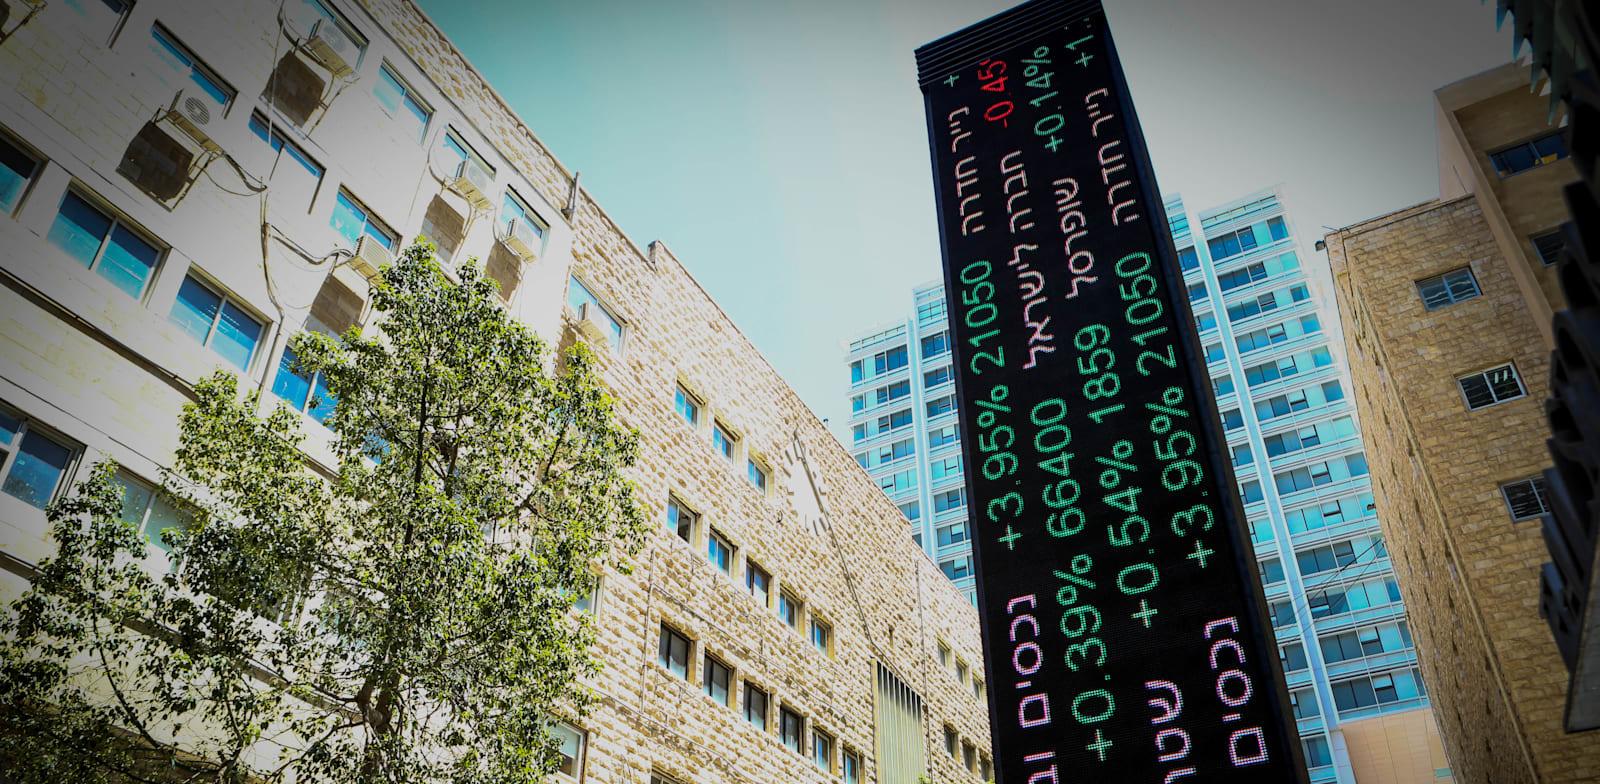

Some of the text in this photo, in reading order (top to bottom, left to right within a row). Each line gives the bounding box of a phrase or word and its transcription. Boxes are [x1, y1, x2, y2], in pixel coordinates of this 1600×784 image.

[948, 106, 972, 153] נייר
[1021, 45, 1065, 152] +0.14%
[1085, 87, 1114, 137] נייר
[955, 155, 986, 237] חדרה
[1052, 177, 1099, 299] שופרסל
[1098, 140, 1140, 226] חדרה
[959, 260, 1006, 375] 21050
[1073, 323, 1126, 424] 1859
[1114, 252, 1177, 377] 21050
[974, 384, 1026, 551] +3.95%
[977, 58, 1117, 762] -0.45 חברה לישראל 66400 +0.39%
[1094, 439, 1161, 629] +0.54%
[1145, 386, 1217, 569] +3.95%
[1006, 593, 1053, 729] נכסים
[1203, 615, 1269, 767] נכסים
